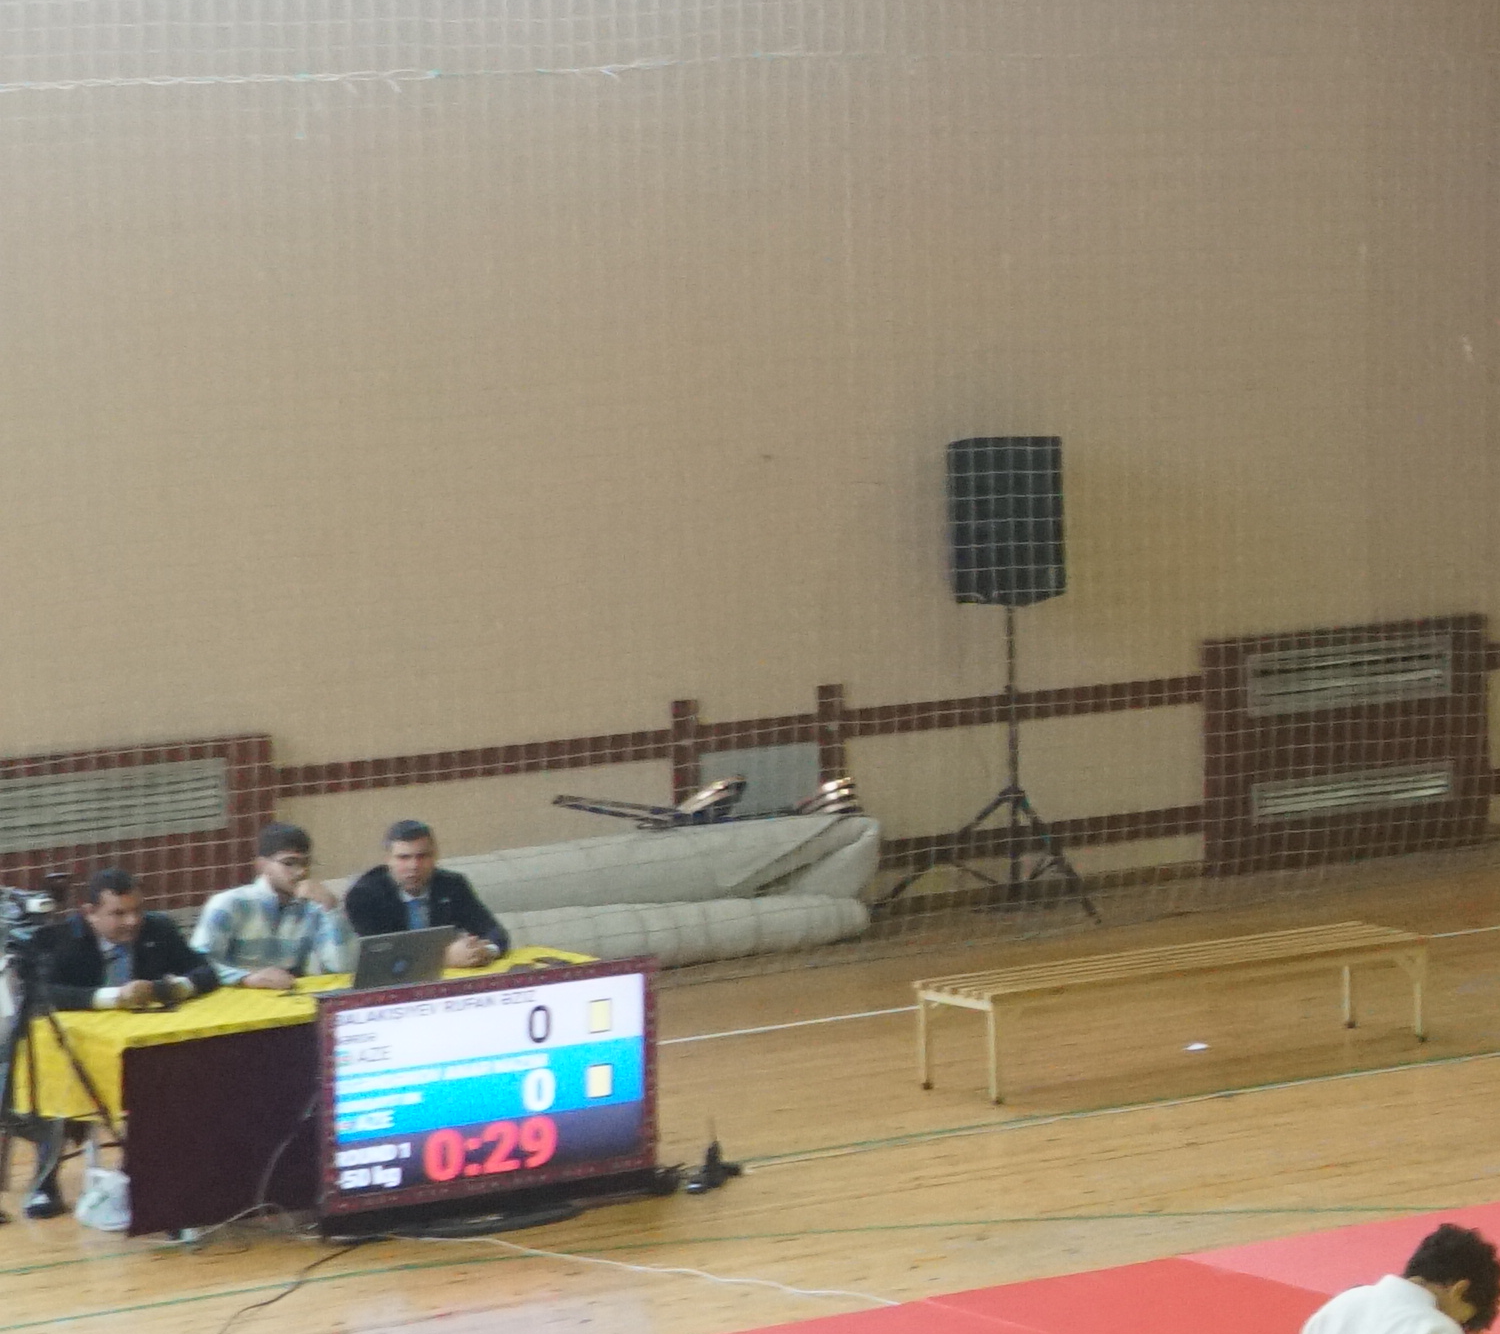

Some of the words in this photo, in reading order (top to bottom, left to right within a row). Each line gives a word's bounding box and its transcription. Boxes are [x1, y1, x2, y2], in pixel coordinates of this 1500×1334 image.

[528, 1005, 552, 1044] 0
[522, 1067, 556, 1113] 0
[422, 1115, 558, 1182] 0:29
[371, 1165, 402, 1189] kg
